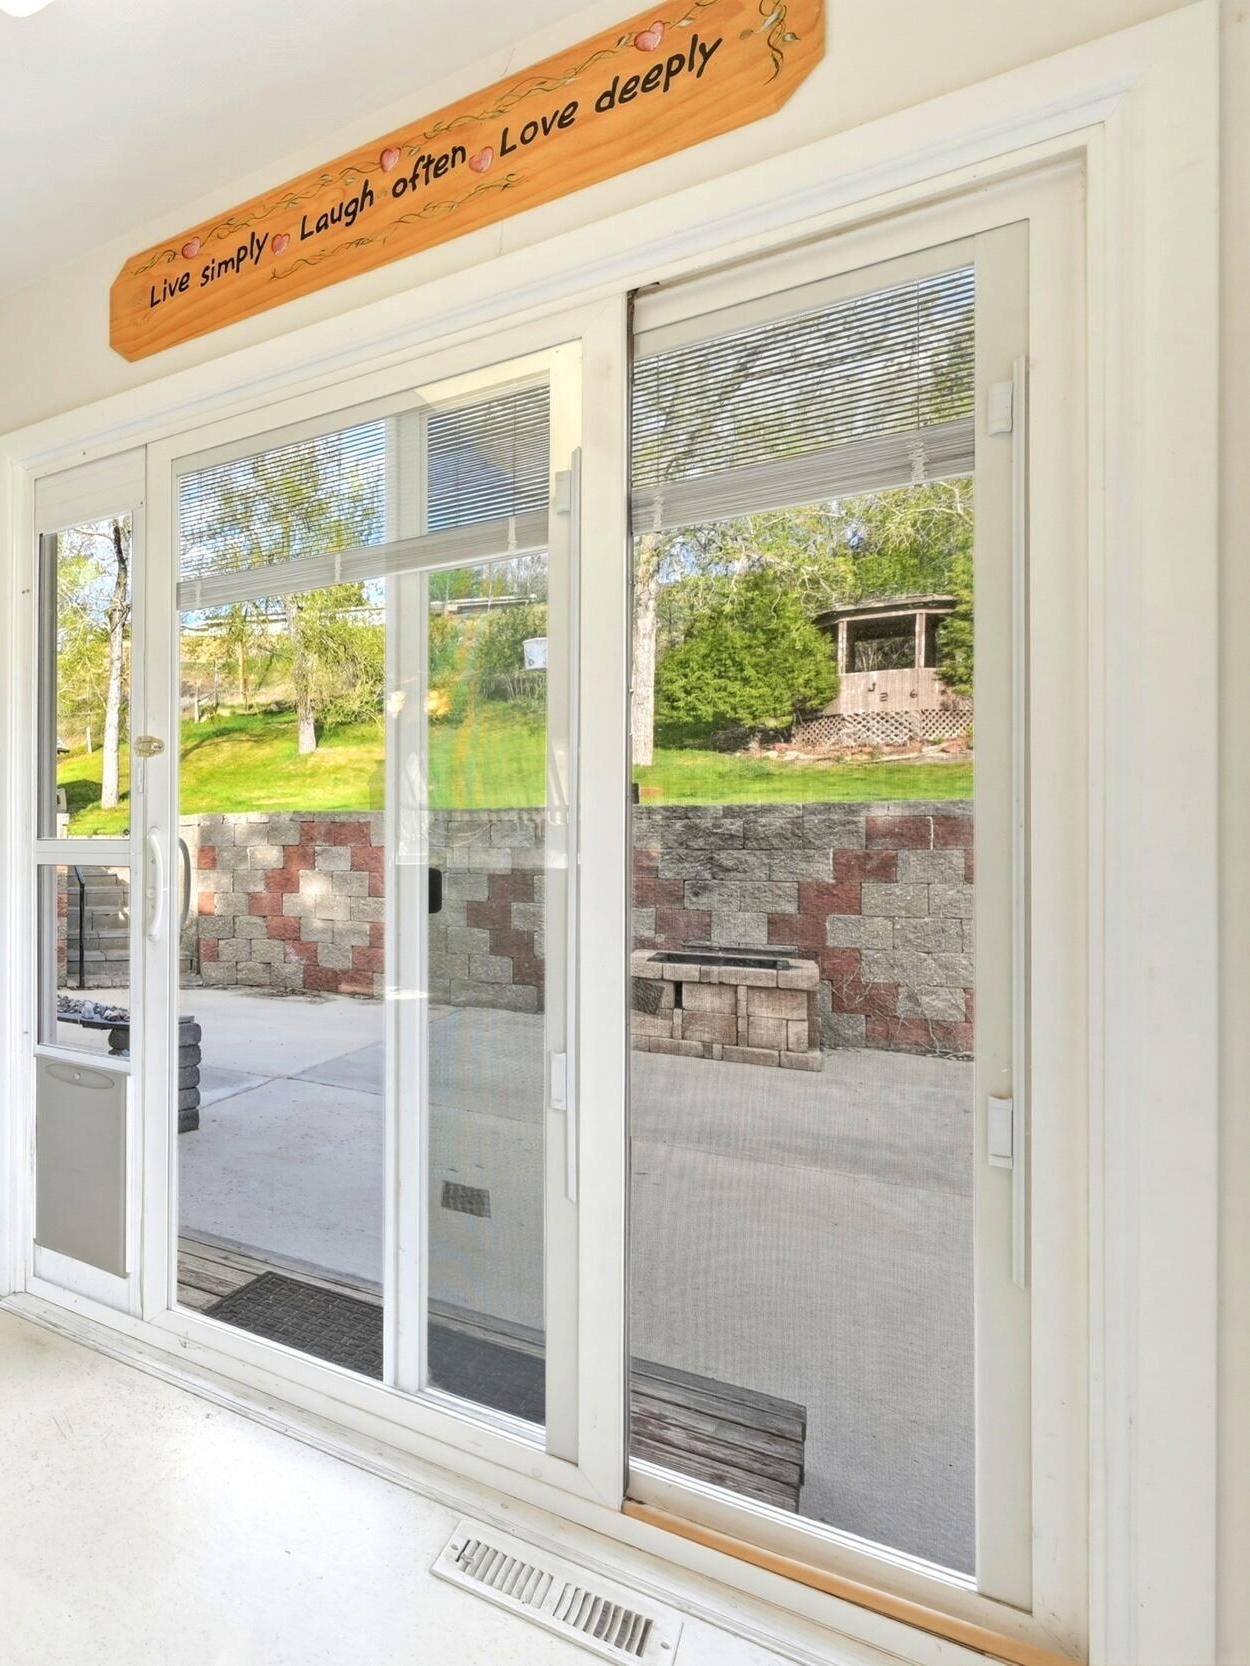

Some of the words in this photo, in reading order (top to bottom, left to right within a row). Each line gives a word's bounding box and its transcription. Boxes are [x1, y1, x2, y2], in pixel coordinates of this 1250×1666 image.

[150, 271, 190, 308] Live
[200, 231, 269, 287] simply
[300, 179, 374, 241] Laugh
[391, 144, 467, 199] often
[499, 101, 580, 157] Love
[595, 33, 724, 113] deeply
